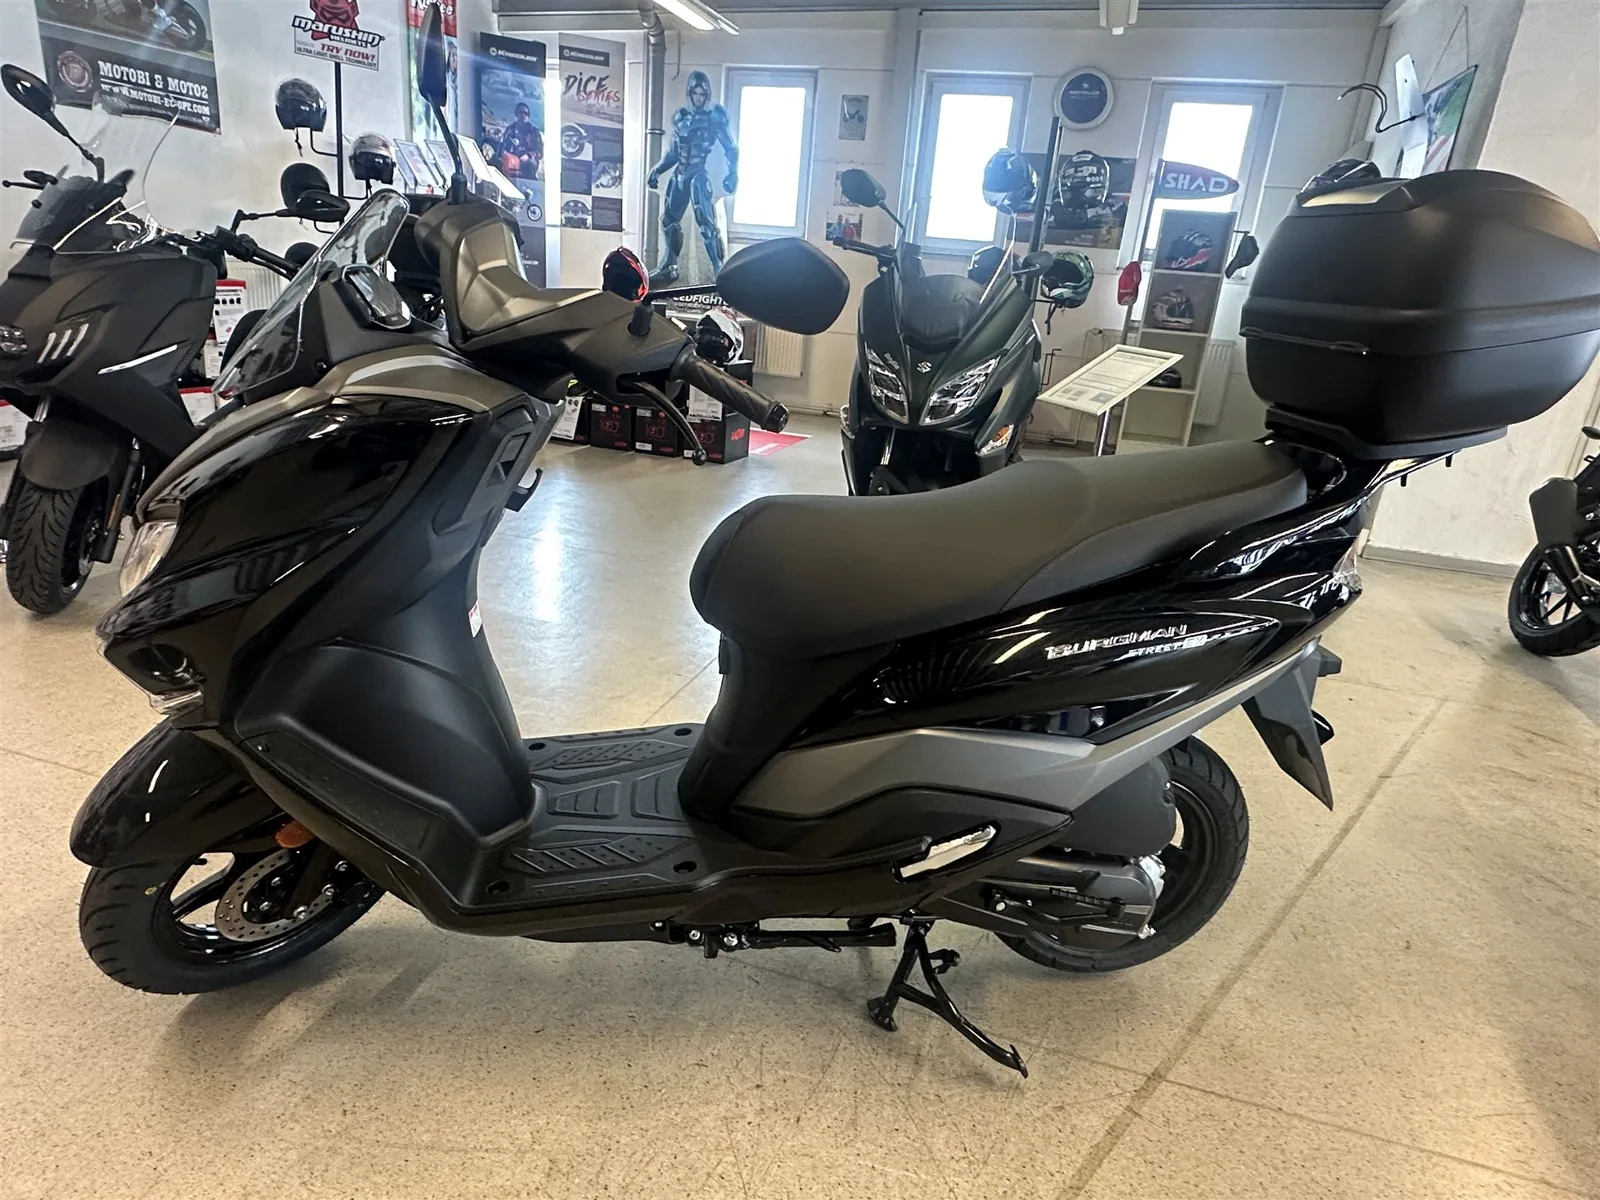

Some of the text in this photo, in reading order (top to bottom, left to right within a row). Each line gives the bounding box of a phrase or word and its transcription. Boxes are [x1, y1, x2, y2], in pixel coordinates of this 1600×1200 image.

[320, 43, 342, 54] TRY
[98, 61, 209, 99] MOTOBI & MOTO2
[1164, 172, 1230, 193] SHAD
[1044, 624, 1188, 660] BURGMAN
[1127, 641, 1184, 657] STREET
